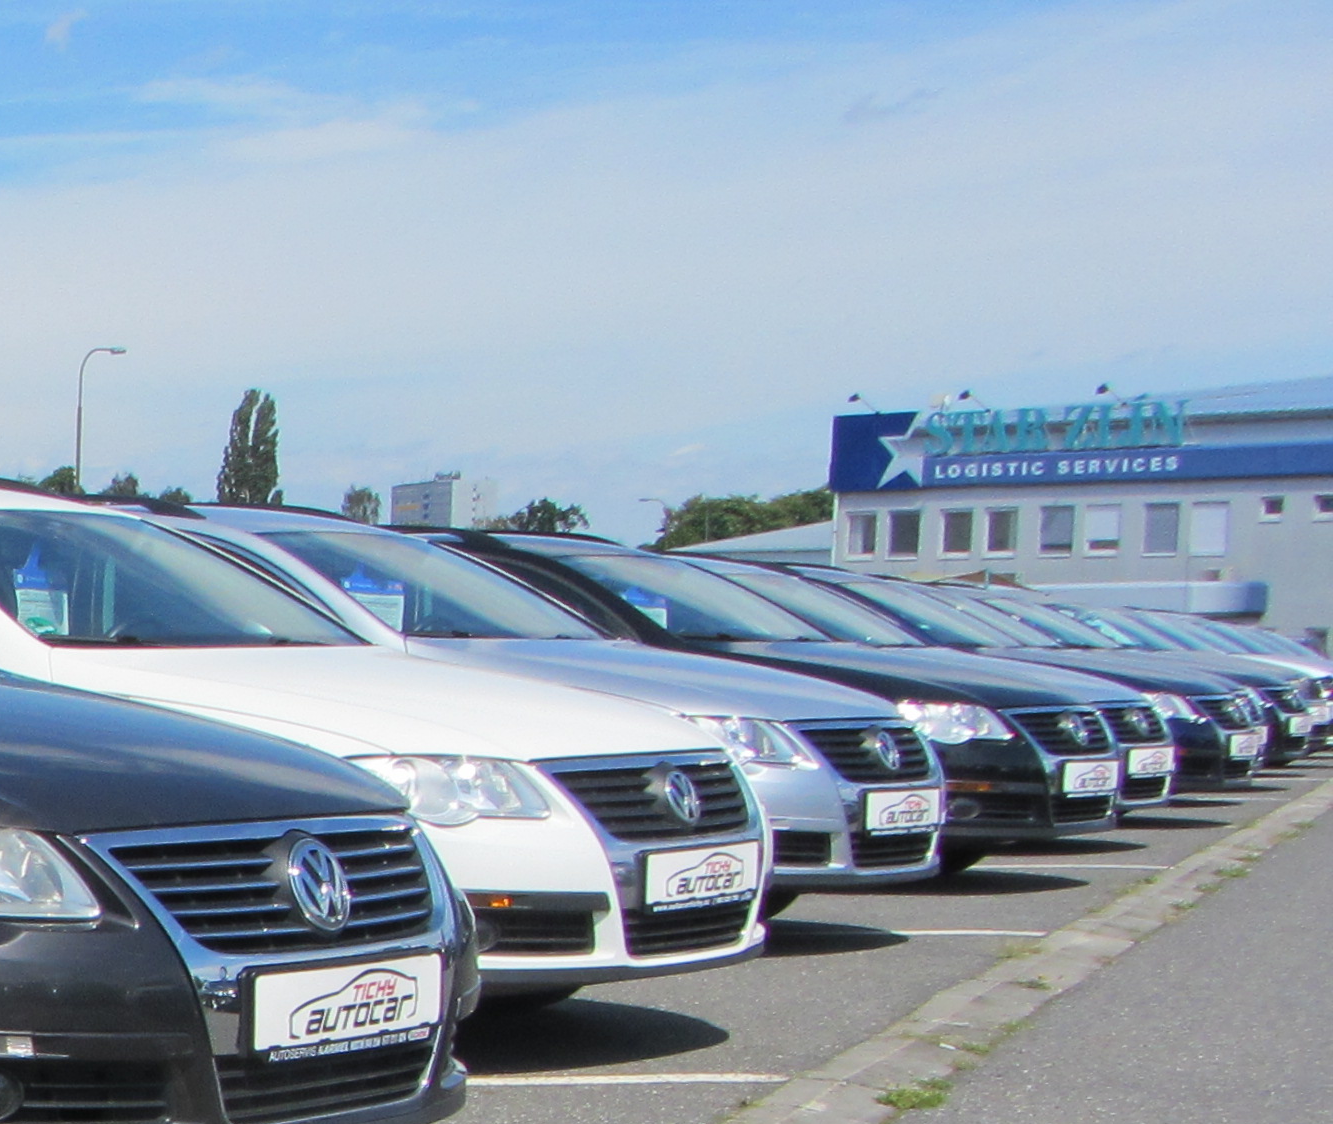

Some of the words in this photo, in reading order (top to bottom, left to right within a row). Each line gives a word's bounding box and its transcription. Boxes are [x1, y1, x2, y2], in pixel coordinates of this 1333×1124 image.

[923, 408, 1050, 456] STAR
[934, 461, 1045, 479] LOGISTIC
[1057, 455, 1180, 475] SERVICES
